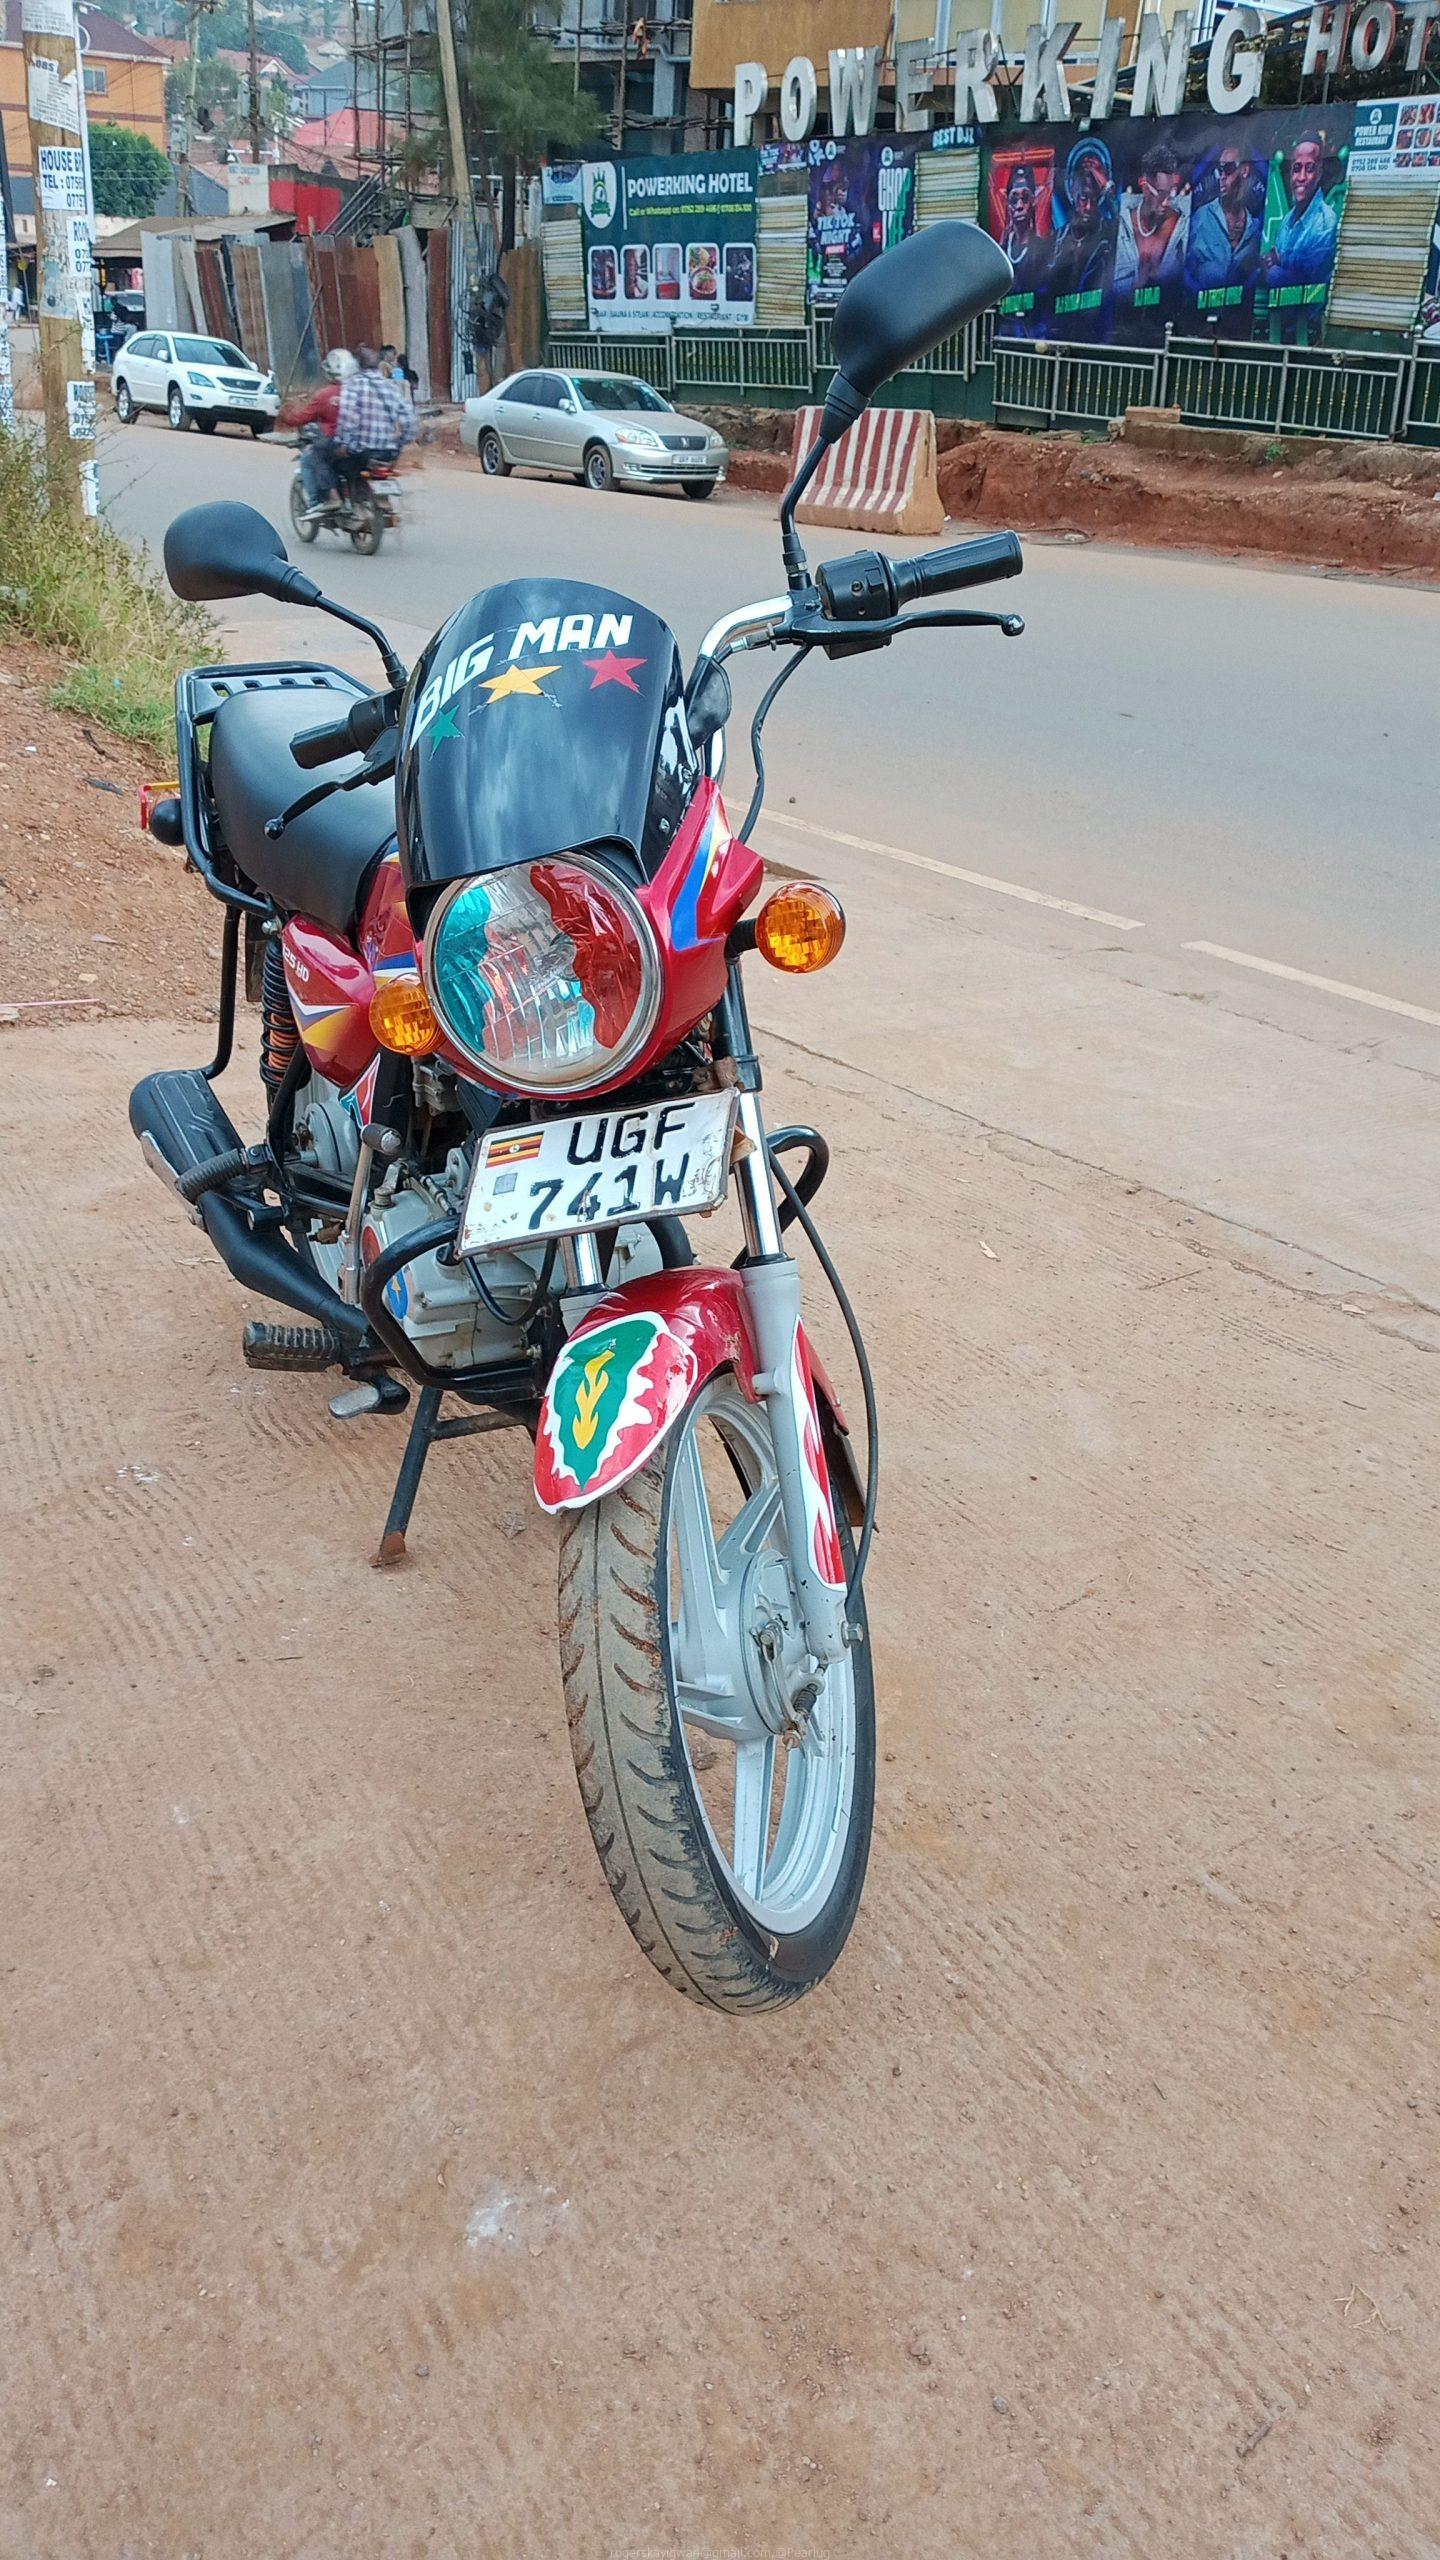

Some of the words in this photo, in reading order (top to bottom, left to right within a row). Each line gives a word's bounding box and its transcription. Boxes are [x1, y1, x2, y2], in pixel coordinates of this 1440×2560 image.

[1301, 0, 1440, 75] HOT
[932, 127, 955, 148] BEST
[1354, 125, 1377, 137] POWER
[1354, 136, 1389, 146] RESTAURANT
[41, 150, 72, 171] HOUSE
[627, 174, 706, 198] POWERKING
[708, 172, 753, 194] HOTEL
[878, 168, 912, 211] CHOP
[820, 229, 852, 245] NIGHT
[409, 632, 495, 751] BIG
[507, 613, 633, 661] MAN
[296, 961, 309, 982] HD
[567, 1102, 695, 1166] UGF
[528, 1153, 690, 1230] 741W
